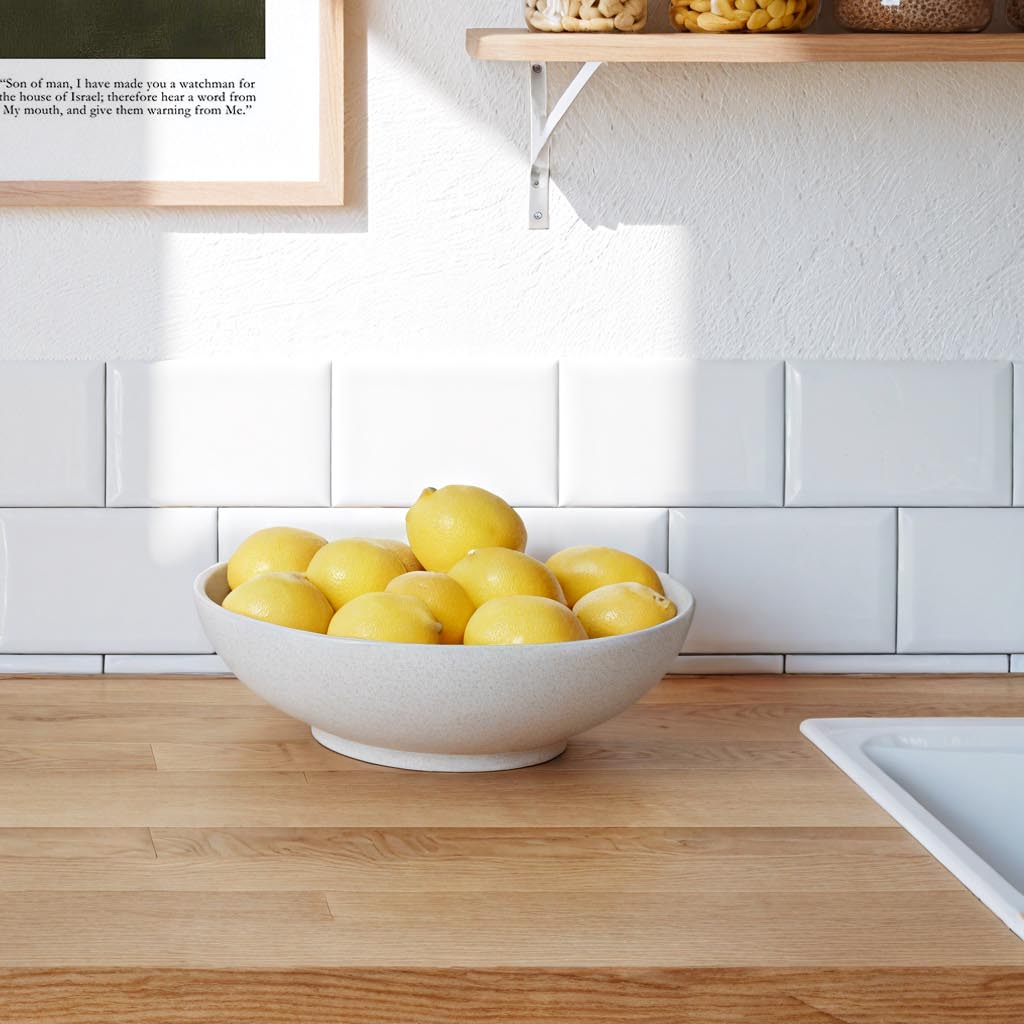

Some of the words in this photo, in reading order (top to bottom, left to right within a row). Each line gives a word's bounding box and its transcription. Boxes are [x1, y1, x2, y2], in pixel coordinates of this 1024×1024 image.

[0, 78, 27, 89] “Son
[30, 77, 45, 89] of
[46, 80, 74, 91] man,
[76, 78, 82, 89] I
[84, 77, 111, 89] have
[113, 77, 144, 89] made
[146, 80, 167, 92] you
[169, 80, 177, 89] a
[179, 77, 236, 89] watchman
[238, 77, 256, 89] for
[18, 91, 51, 102] house
[54, 90, 69, 102] of
[71, 91, 105, 103] Israel;
[107, 90, 158, 102] therefore
[160, 91, 186, 102] hear
[187, 94, 195, 102] a
[197, 91, 226, 102] word
[229, 90, 257, 102] from
[2, 104, 21, 118] My
[23, 104, 64, 117] mouth,
[66, 104, 87, 115] and
[89, 104, 113, 118] give
[115, 104, 144, 115] them
[146, 104, 192, 118] warning
[194, 103, 222, 115] from
